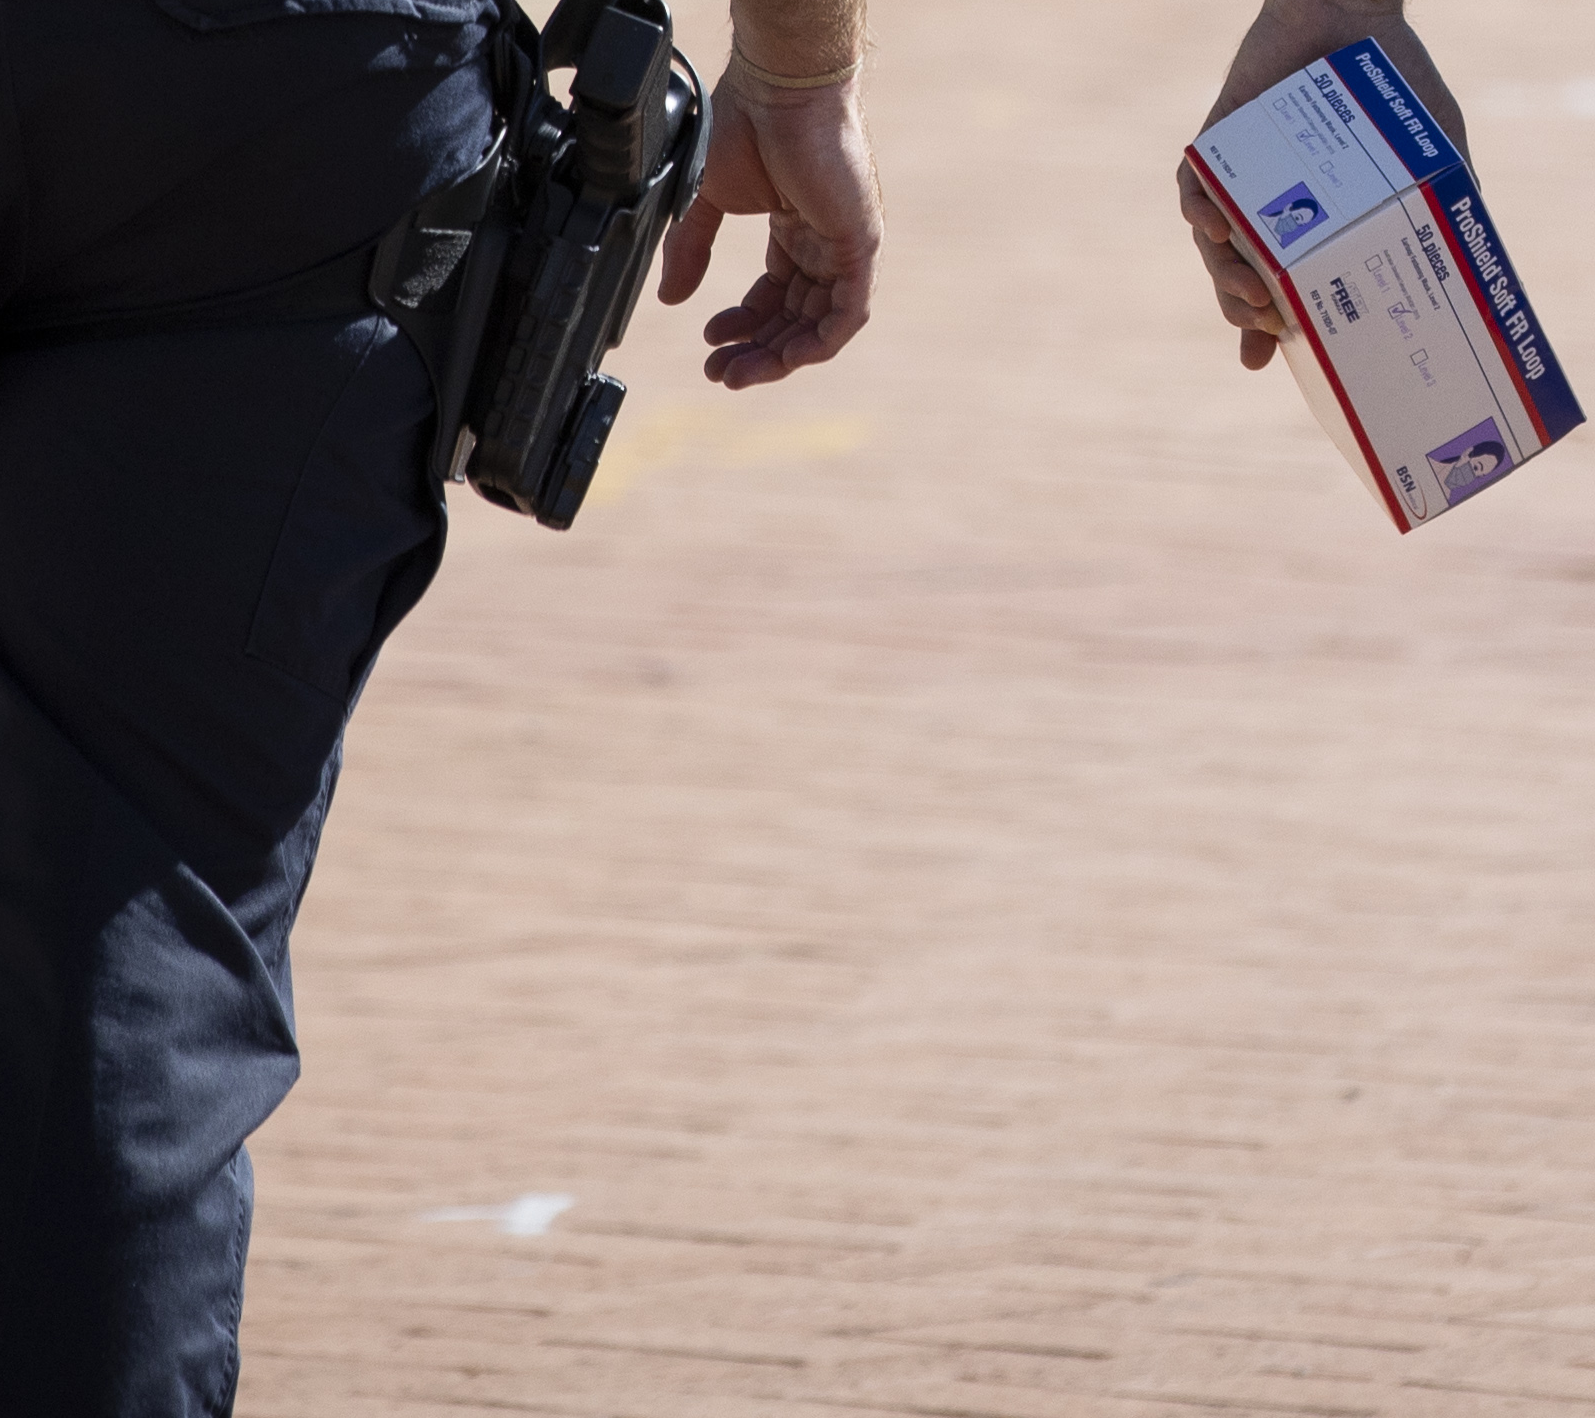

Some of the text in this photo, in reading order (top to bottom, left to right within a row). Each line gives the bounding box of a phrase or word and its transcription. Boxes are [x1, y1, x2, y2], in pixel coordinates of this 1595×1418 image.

[1313, 73, 1333, 90] 50
[1323, 90, 1354, 125] pieces
[1389, 98, 1412, 119] Soft
[1404, 118, 1423, 133] FR
[1415, 132, 1438, 157] Loop
[1415, 224, 1449, 283] 50 pieces
[1310, 289, 1320, 300] REF
[1330, 278, 1359, 322] FREE
[1428, 292, 1438, 306] Level
[1373, 269, 1388, 288] Level
[1395, 316, 1410, 334] Level
[1418, 362, 1433, 380] Level
[1490, 277, 1516, 316] Soft
[1506, 310, 1528, 340] FR
[1518, 335, 1544, 379] Loop
[1396, 466, 1415, 492] BSN
